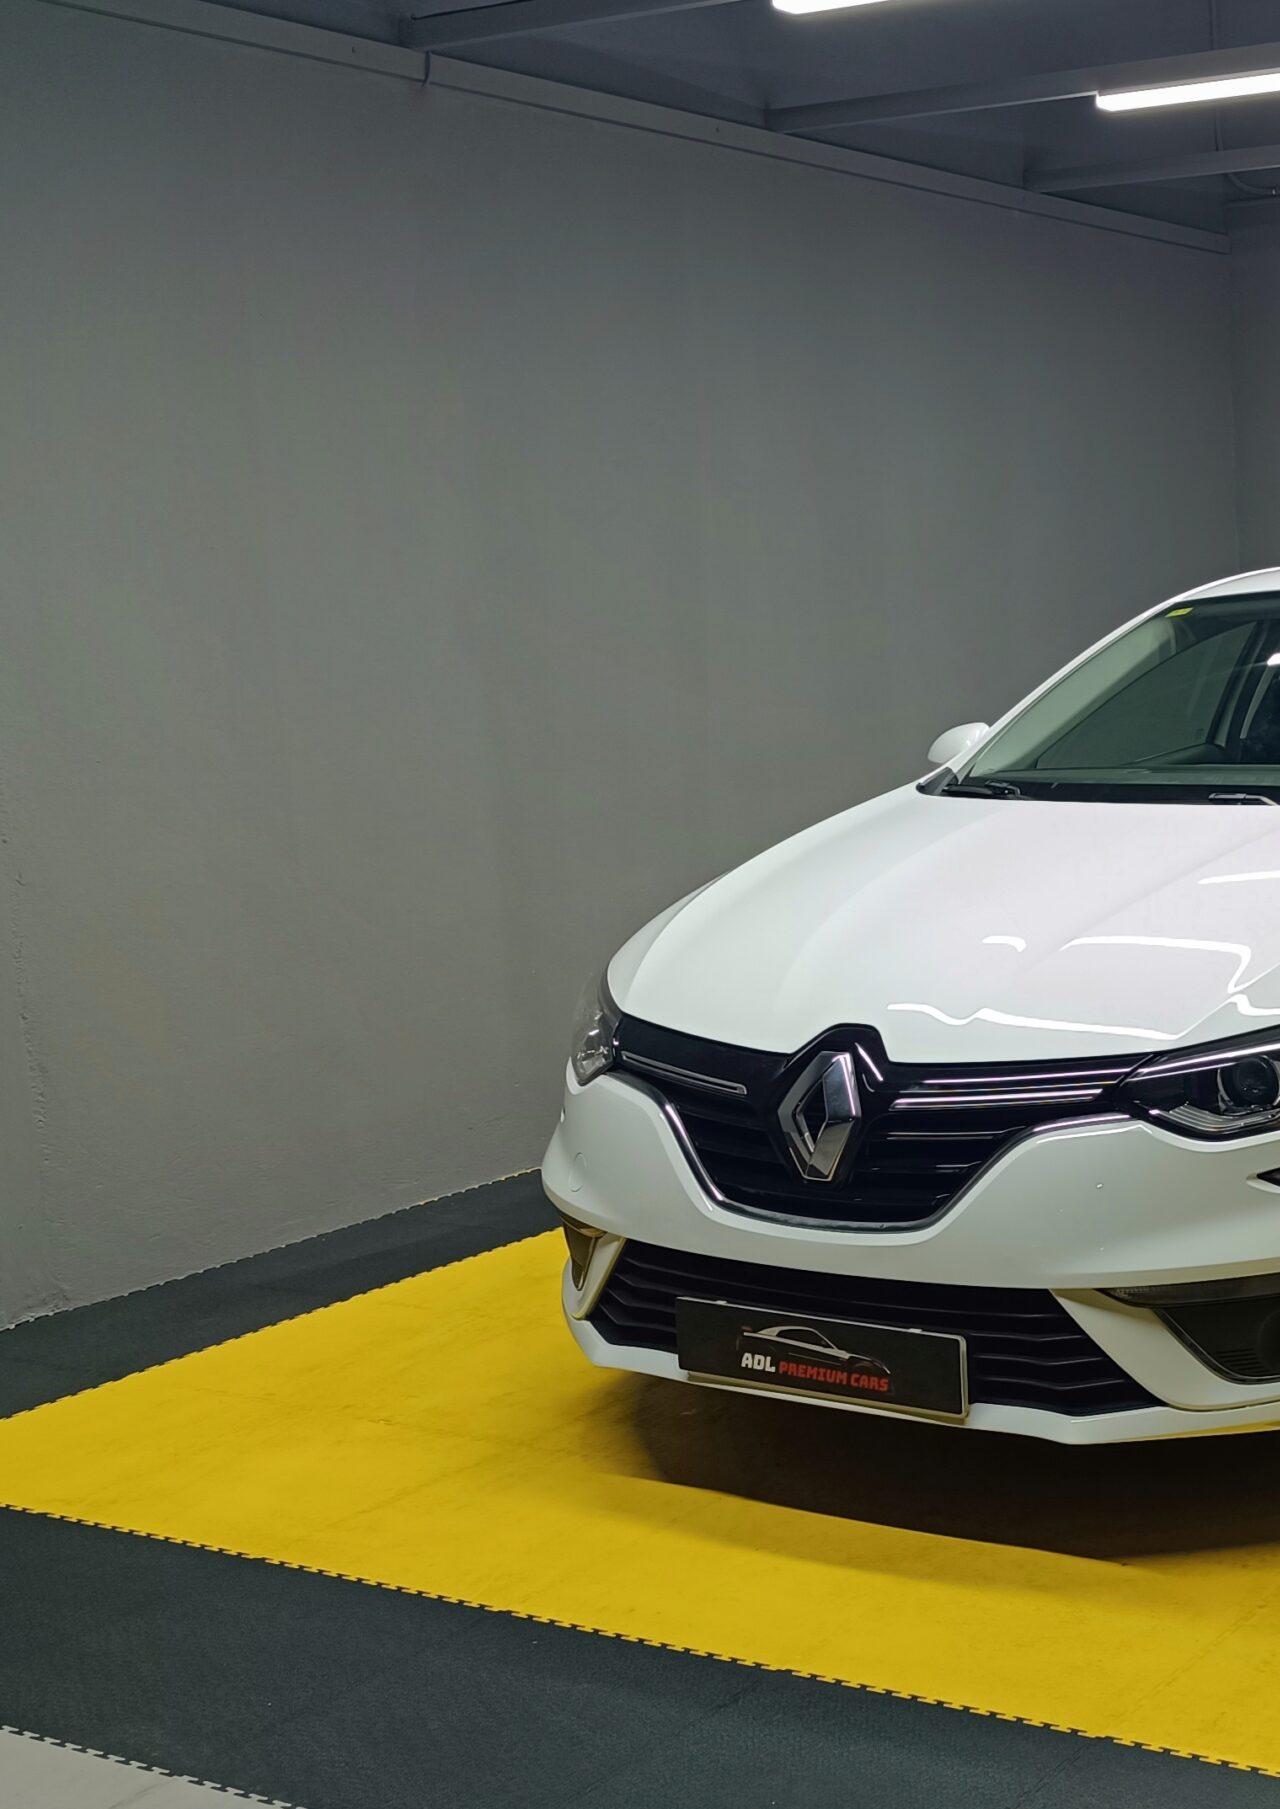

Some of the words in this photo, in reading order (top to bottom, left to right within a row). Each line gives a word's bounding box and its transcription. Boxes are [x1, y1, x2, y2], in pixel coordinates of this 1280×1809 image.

[741, 1352, 776, 1373] ADL
[778, 1361, 848, 1384] PREMIUM
[850, 1374, 889, 1391] CARS
